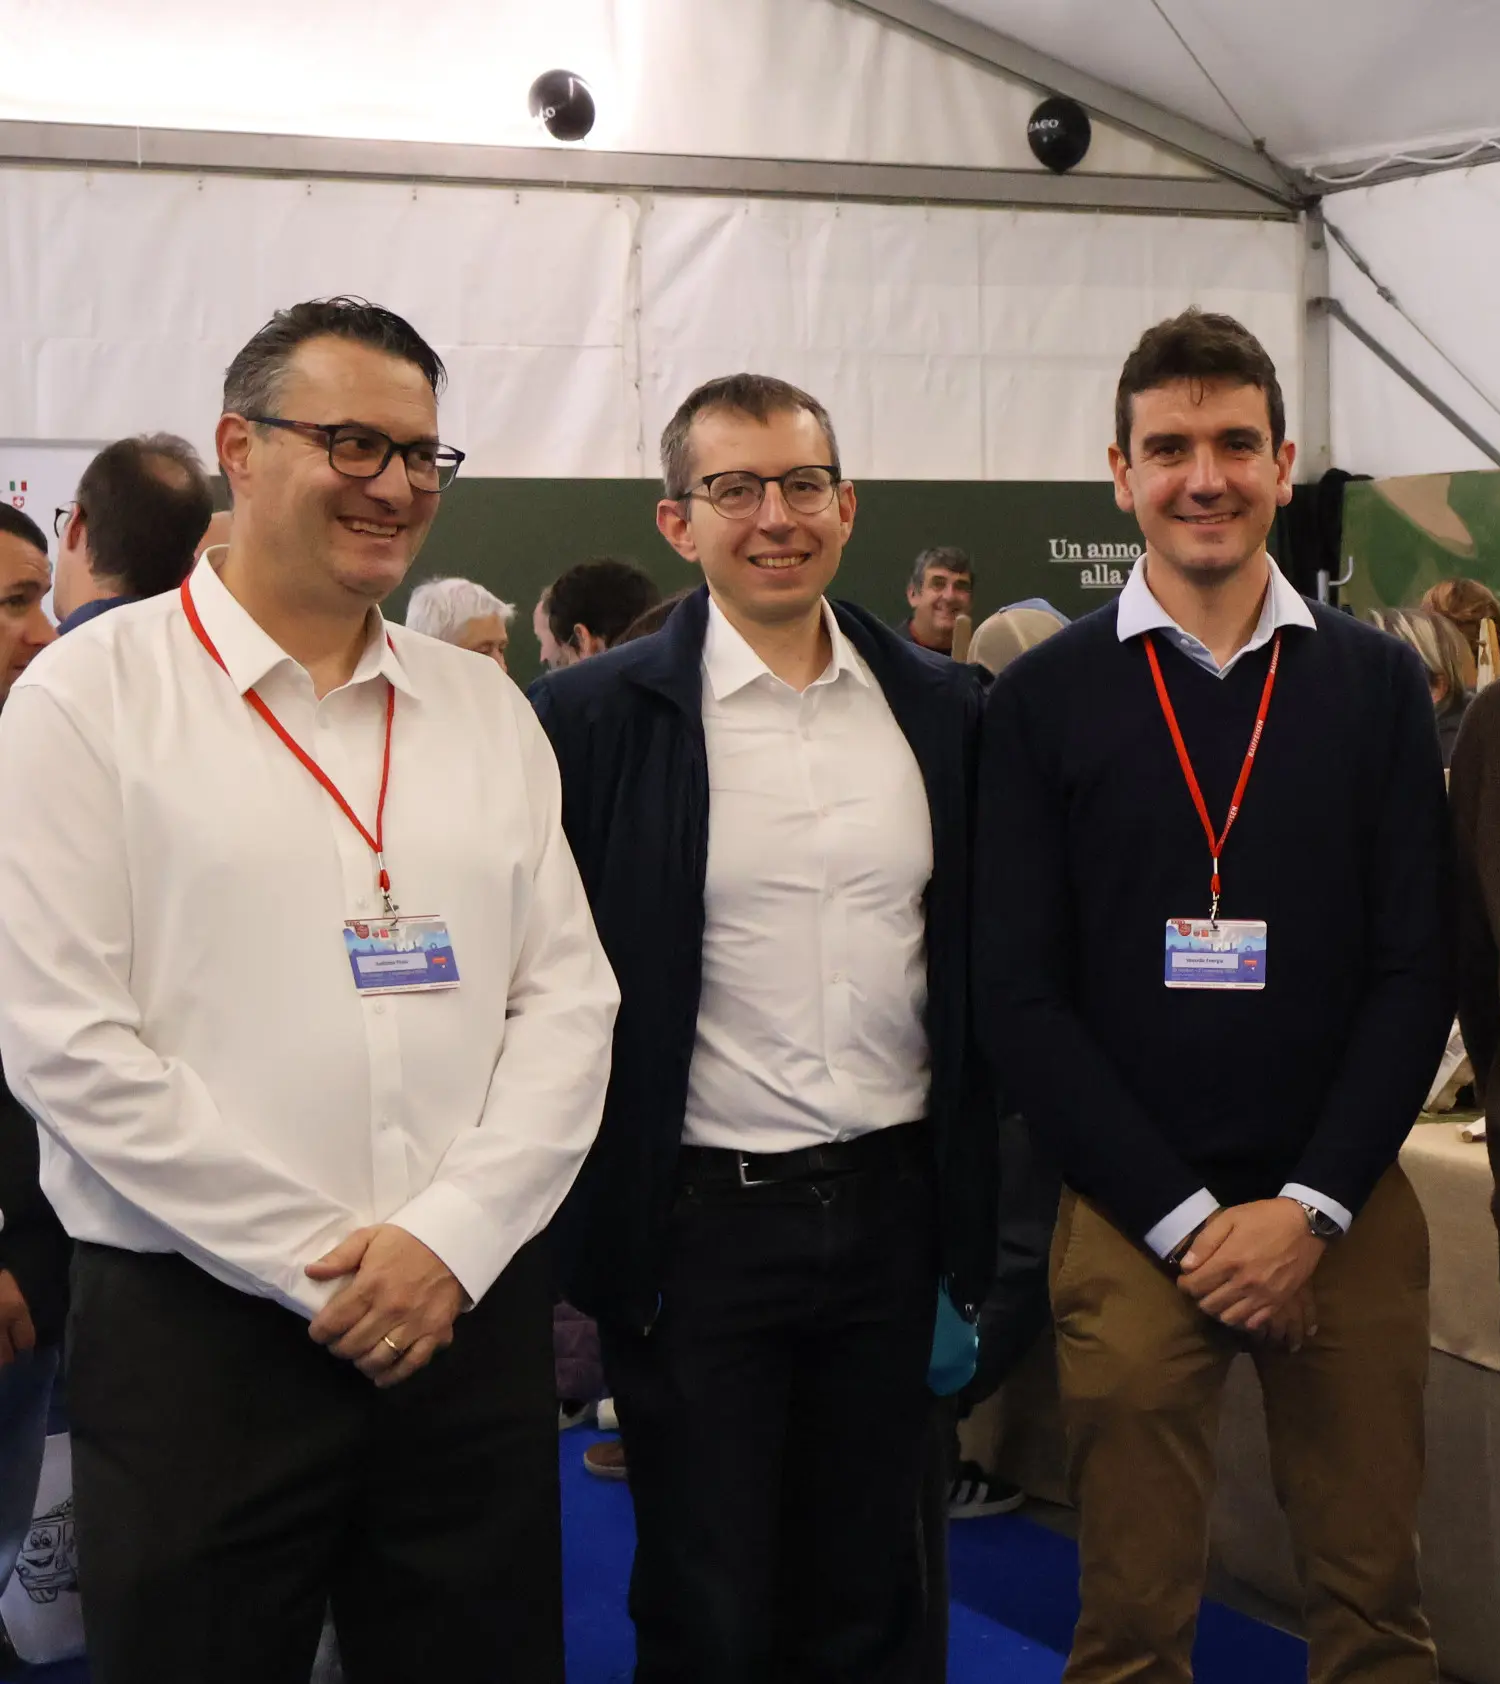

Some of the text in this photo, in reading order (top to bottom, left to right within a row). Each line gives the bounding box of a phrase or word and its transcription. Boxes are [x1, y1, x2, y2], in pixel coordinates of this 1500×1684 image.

[1048, 539, 1142, 559] Un anno
[1080, 564, 1124, 585] alla
[1248, 719, 1264, 758] RAIFFEISEN
